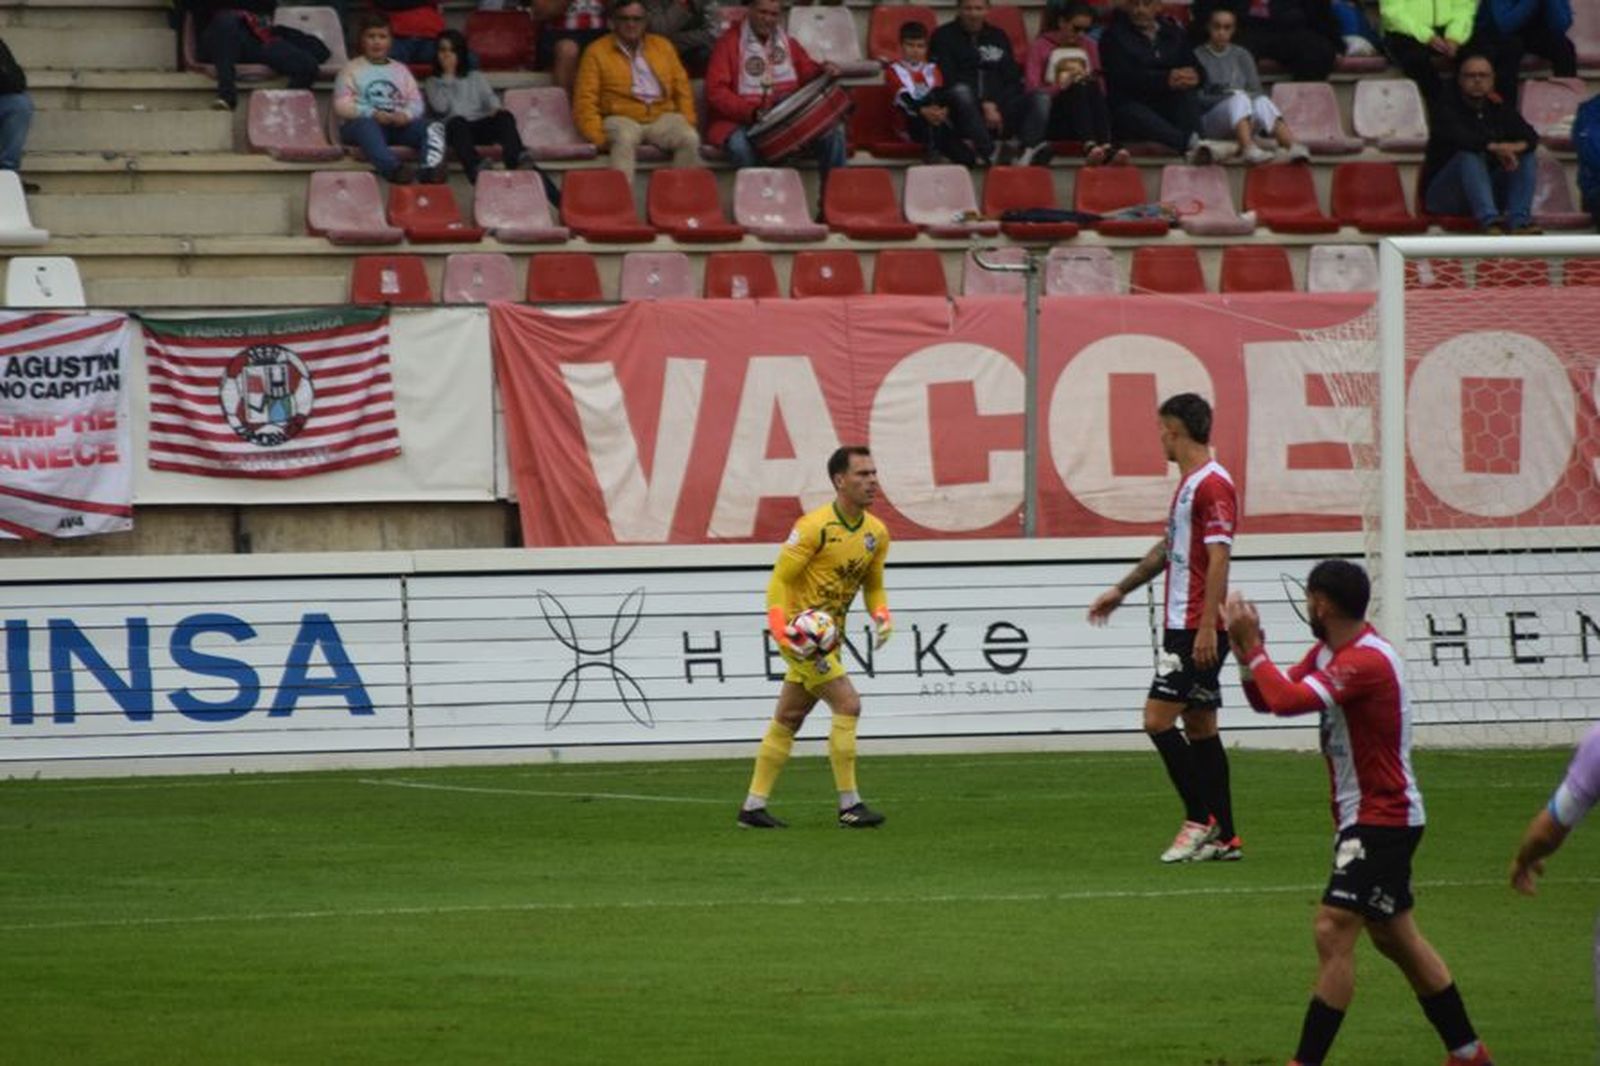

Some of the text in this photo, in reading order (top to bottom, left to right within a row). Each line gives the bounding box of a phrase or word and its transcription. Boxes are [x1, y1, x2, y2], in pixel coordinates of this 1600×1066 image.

[4, 347, 119, 378] AGUSTIN
[30, 373, 119, 399] CAPITAN
[556, 332, 1600, 542] VACCEO
[4, 612, 376, 725] INSA
[919, 679, 1033, 697] ART SALON
